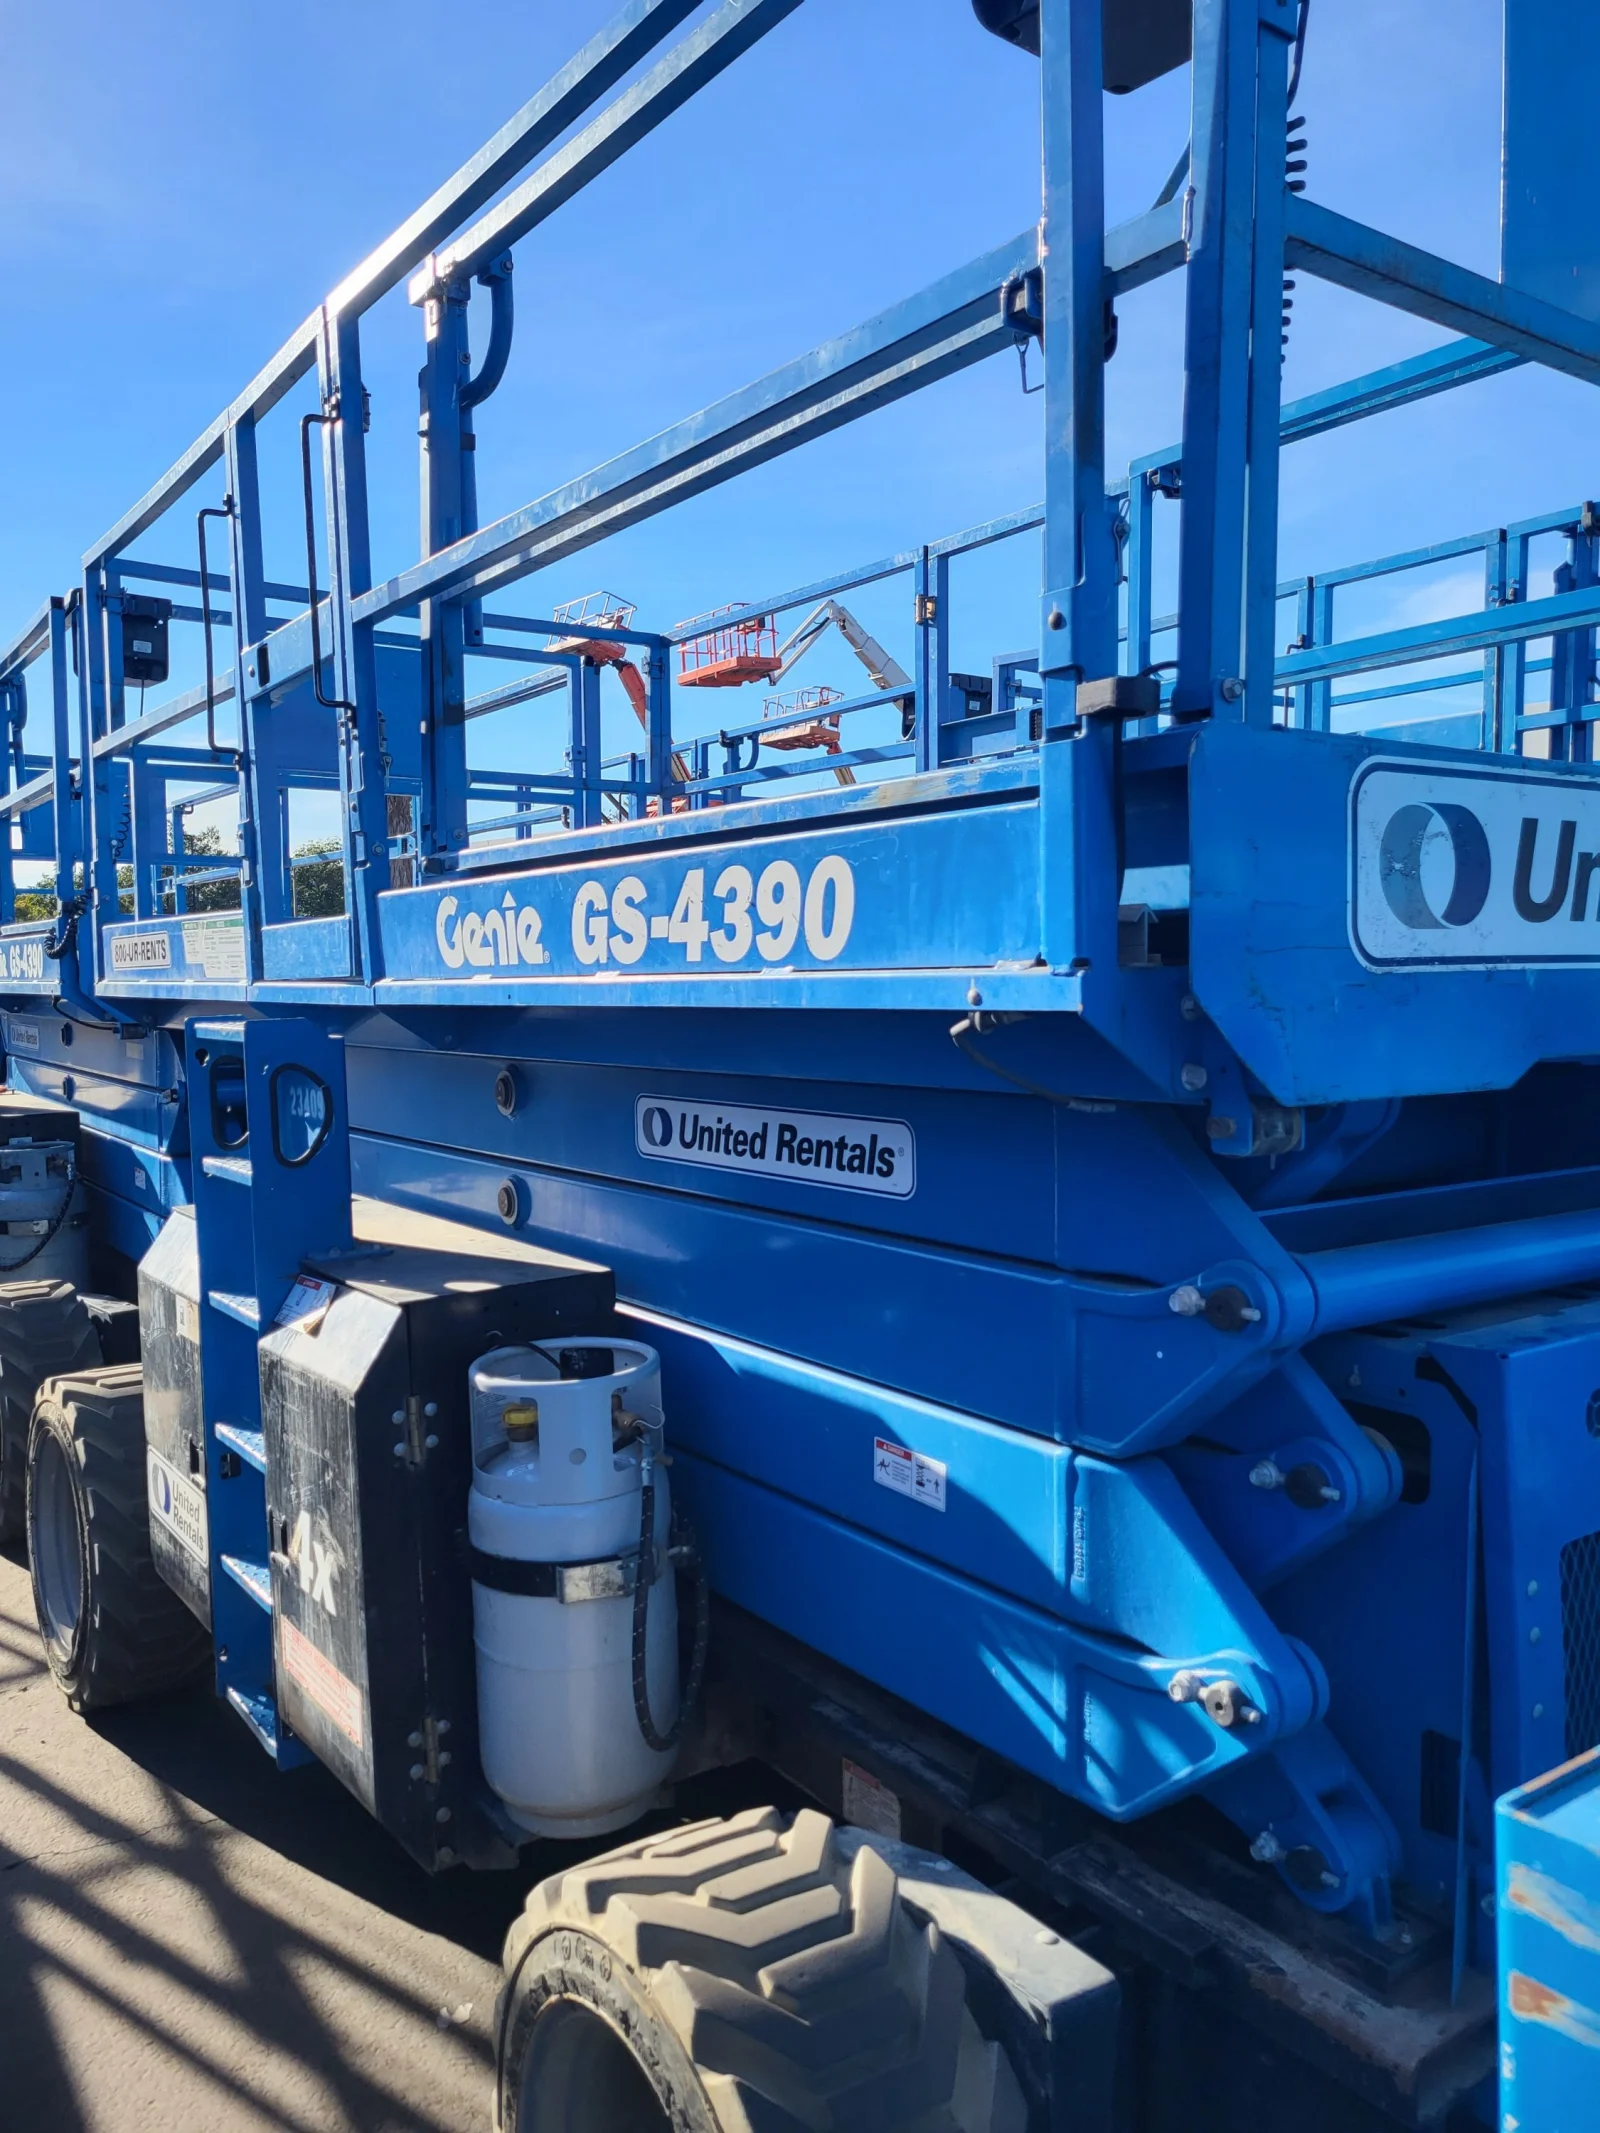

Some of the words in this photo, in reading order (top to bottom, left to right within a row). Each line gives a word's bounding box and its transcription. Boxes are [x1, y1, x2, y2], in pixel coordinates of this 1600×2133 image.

[436, 890, 545, 968] Genie
[571, 855, 855, 965] GS-4390
[10, 943, 43, 978] GS-4390
[115, 939, 166, 962] 800-UR-RENTS
[679, 1113, 768, 1160] United
[775, 1123, 895, 1178] Rentals
[172, 1480, 200, 1523] United
[173, 1505, 204, 1552] Rentals
